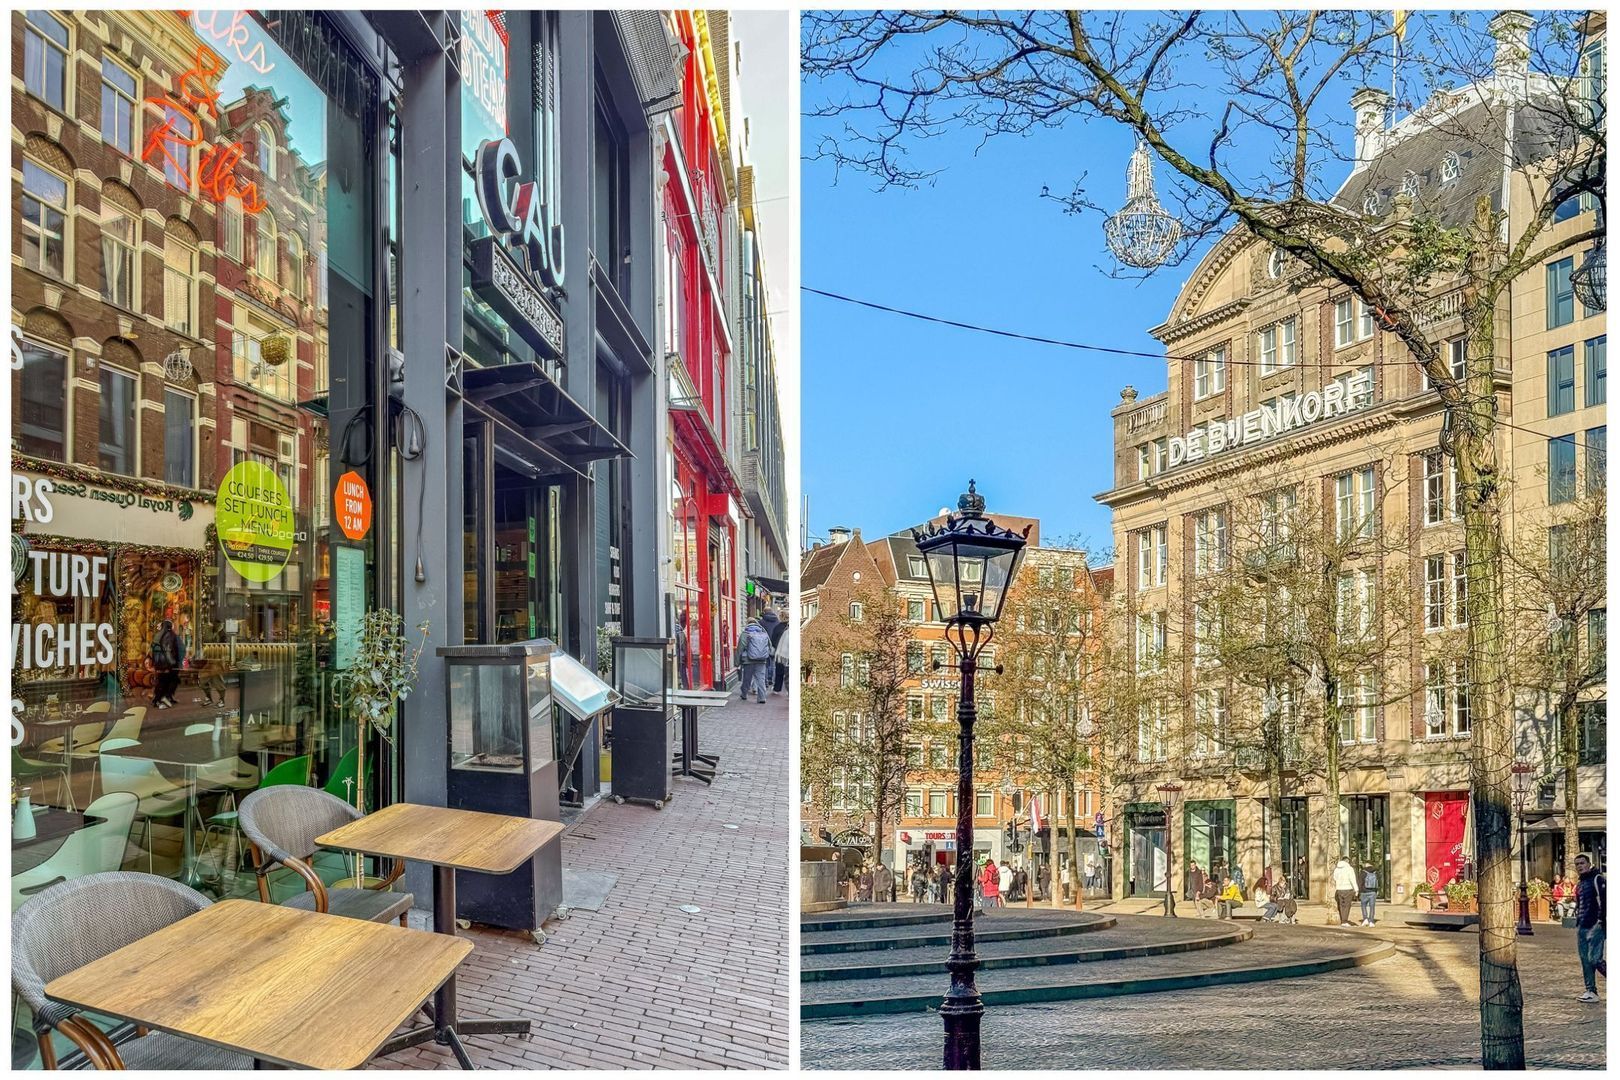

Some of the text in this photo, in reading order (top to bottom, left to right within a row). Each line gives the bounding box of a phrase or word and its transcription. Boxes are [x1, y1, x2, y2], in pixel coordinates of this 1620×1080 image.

[476, 138, 565, 292] CAU
[1169, 373, 1371, 467] DE BIJENKORF
[343, 480, 364, 499] LUNCH
[224, 497, 288, 523] SET LUNCH
[345, 498, 363, 515] FROM
[241, 518, 274, 537] MENU
[344, 515, 352, 530] 12
[28, 550, 108, 598] TURF
[924, 832, 946, 840] TOURS
